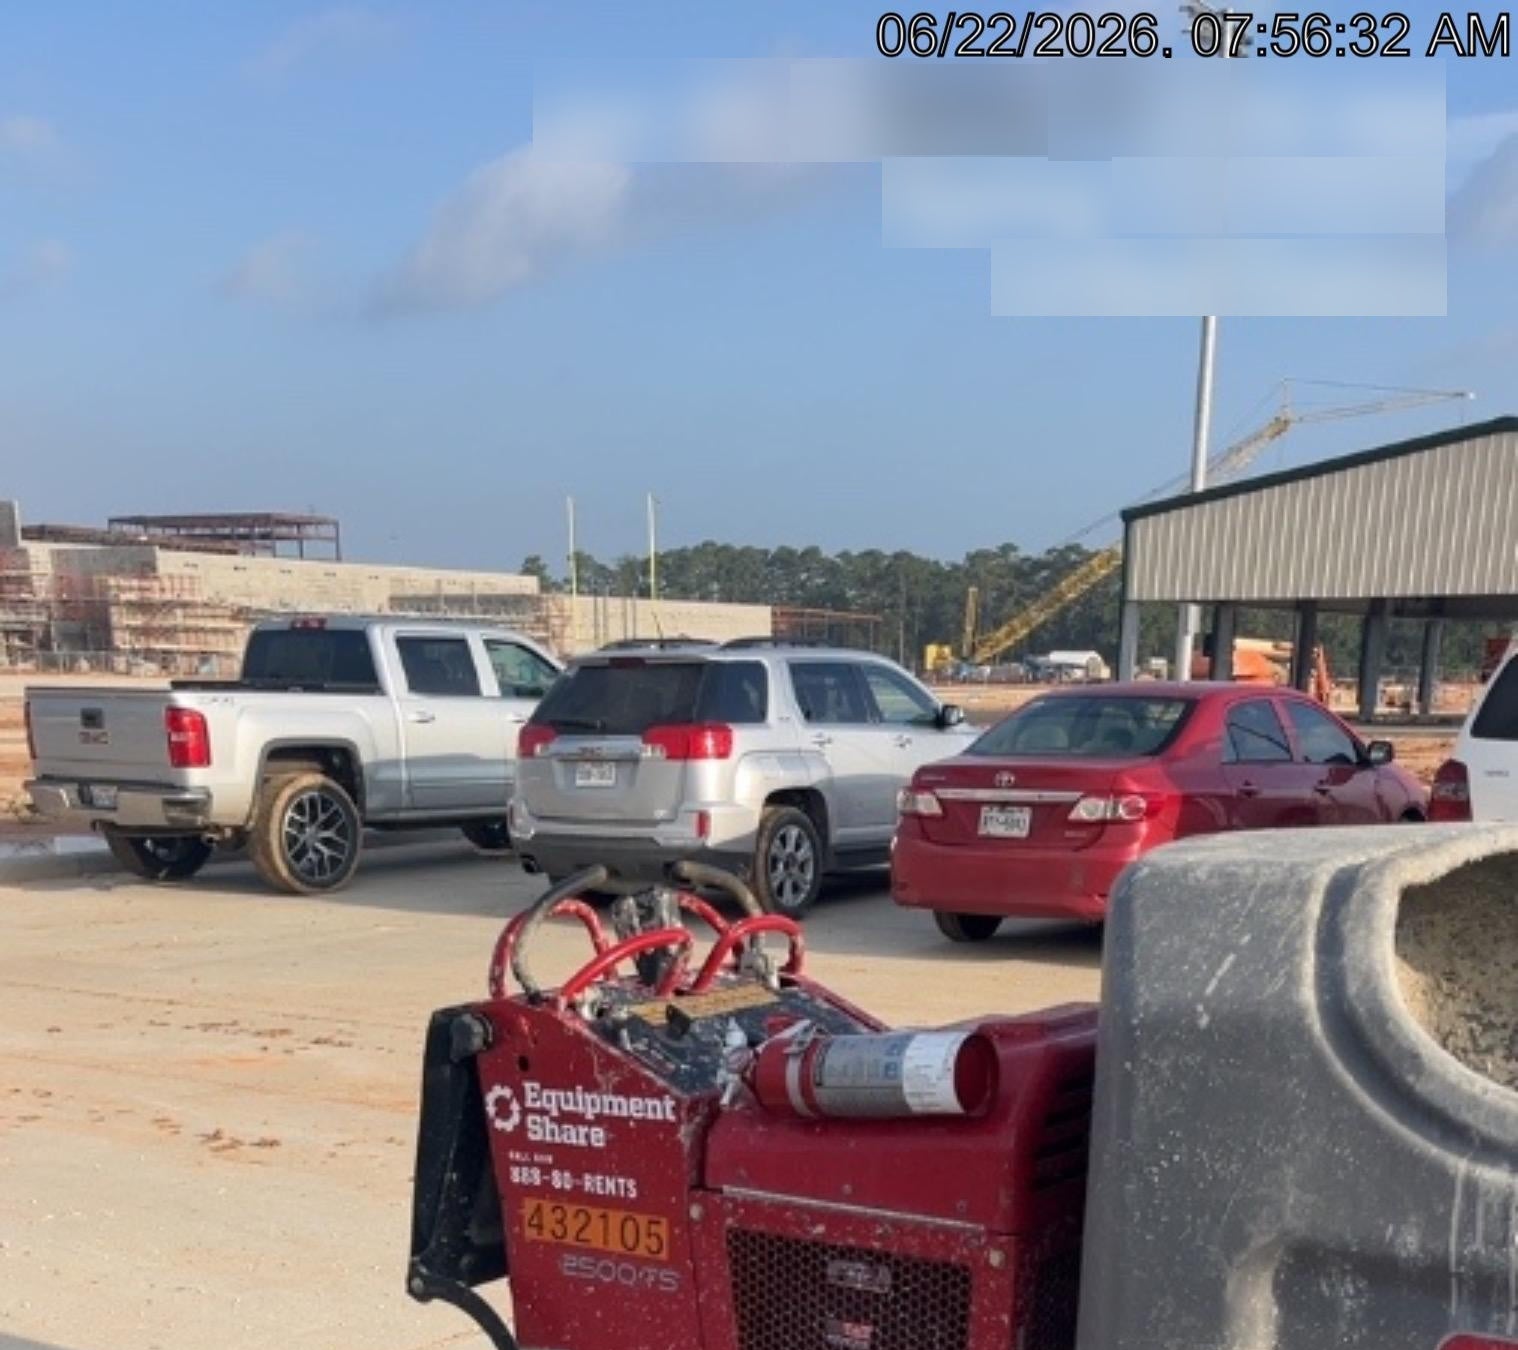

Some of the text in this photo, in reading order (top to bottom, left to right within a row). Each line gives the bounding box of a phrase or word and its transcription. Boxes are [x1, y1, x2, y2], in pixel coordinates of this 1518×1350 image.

[523, 1082, 676, 1120] Equipment
[526, 1114, 606, 1147] Share
[527, 1203, 664, 1255] 432105
